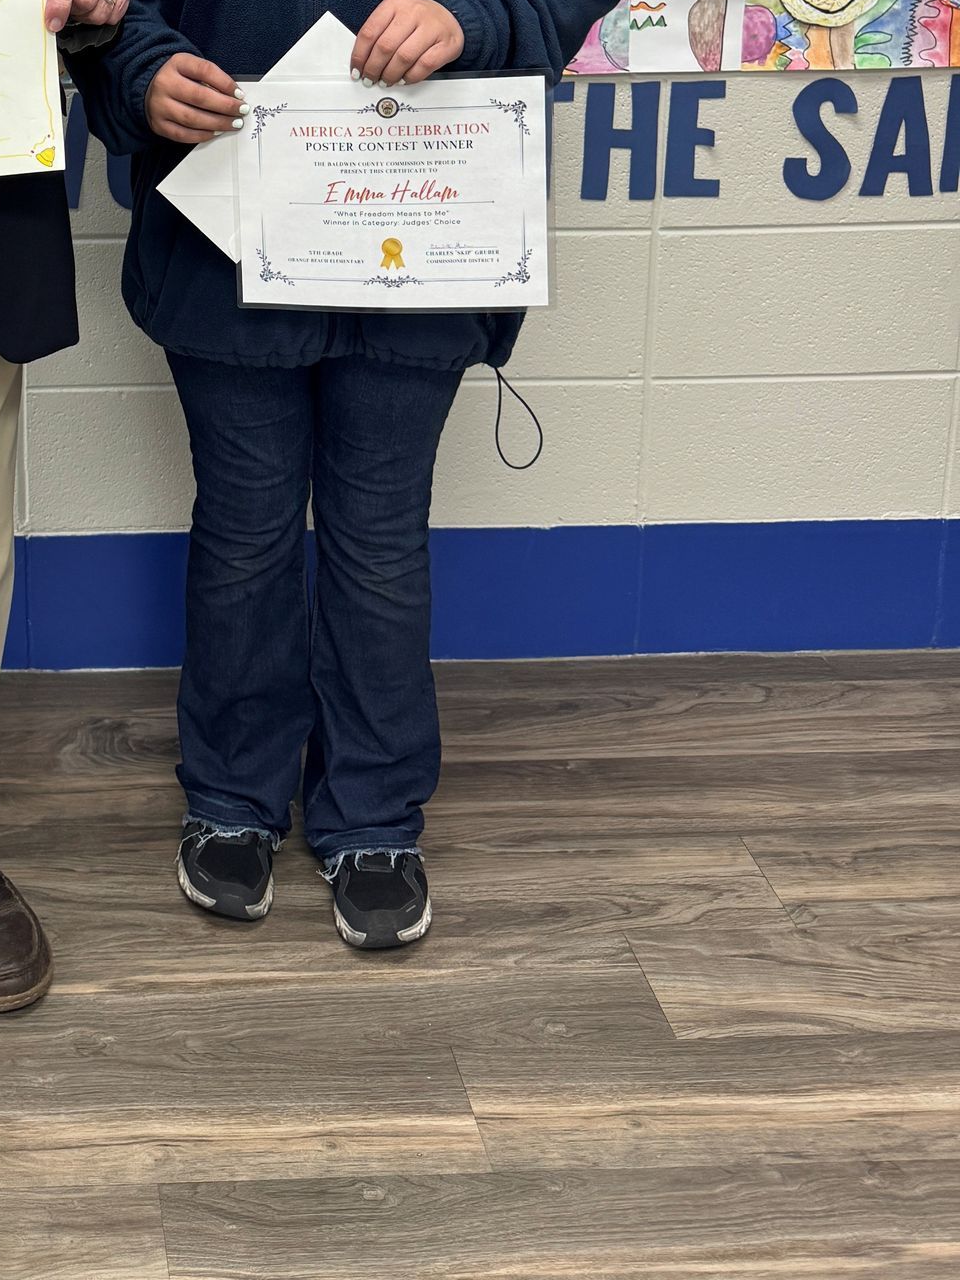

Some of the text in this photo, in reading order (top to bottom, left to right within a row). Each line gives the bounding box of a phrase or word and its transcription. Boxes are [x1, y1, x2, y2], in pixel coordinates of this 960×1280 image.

[290, 122, 490, 138] AMERICA 250 CELEBRATION
[553, 79, 727, 201] HE
[784, 76, 960, 201] SA
[305, 140, 474, 152] POSTER CONTEST WINNER
[324, 179, 460, 204] Emma Hallam
[334, 210, 357, 218] "What
[359, 210, 395, 218] Freedom
[435, 209, 450, 217] Me"
[361, 218, 400, 227] Category:
[402, 218, 433, 227] Judges'
[434, 218, 461, 226] Choice
